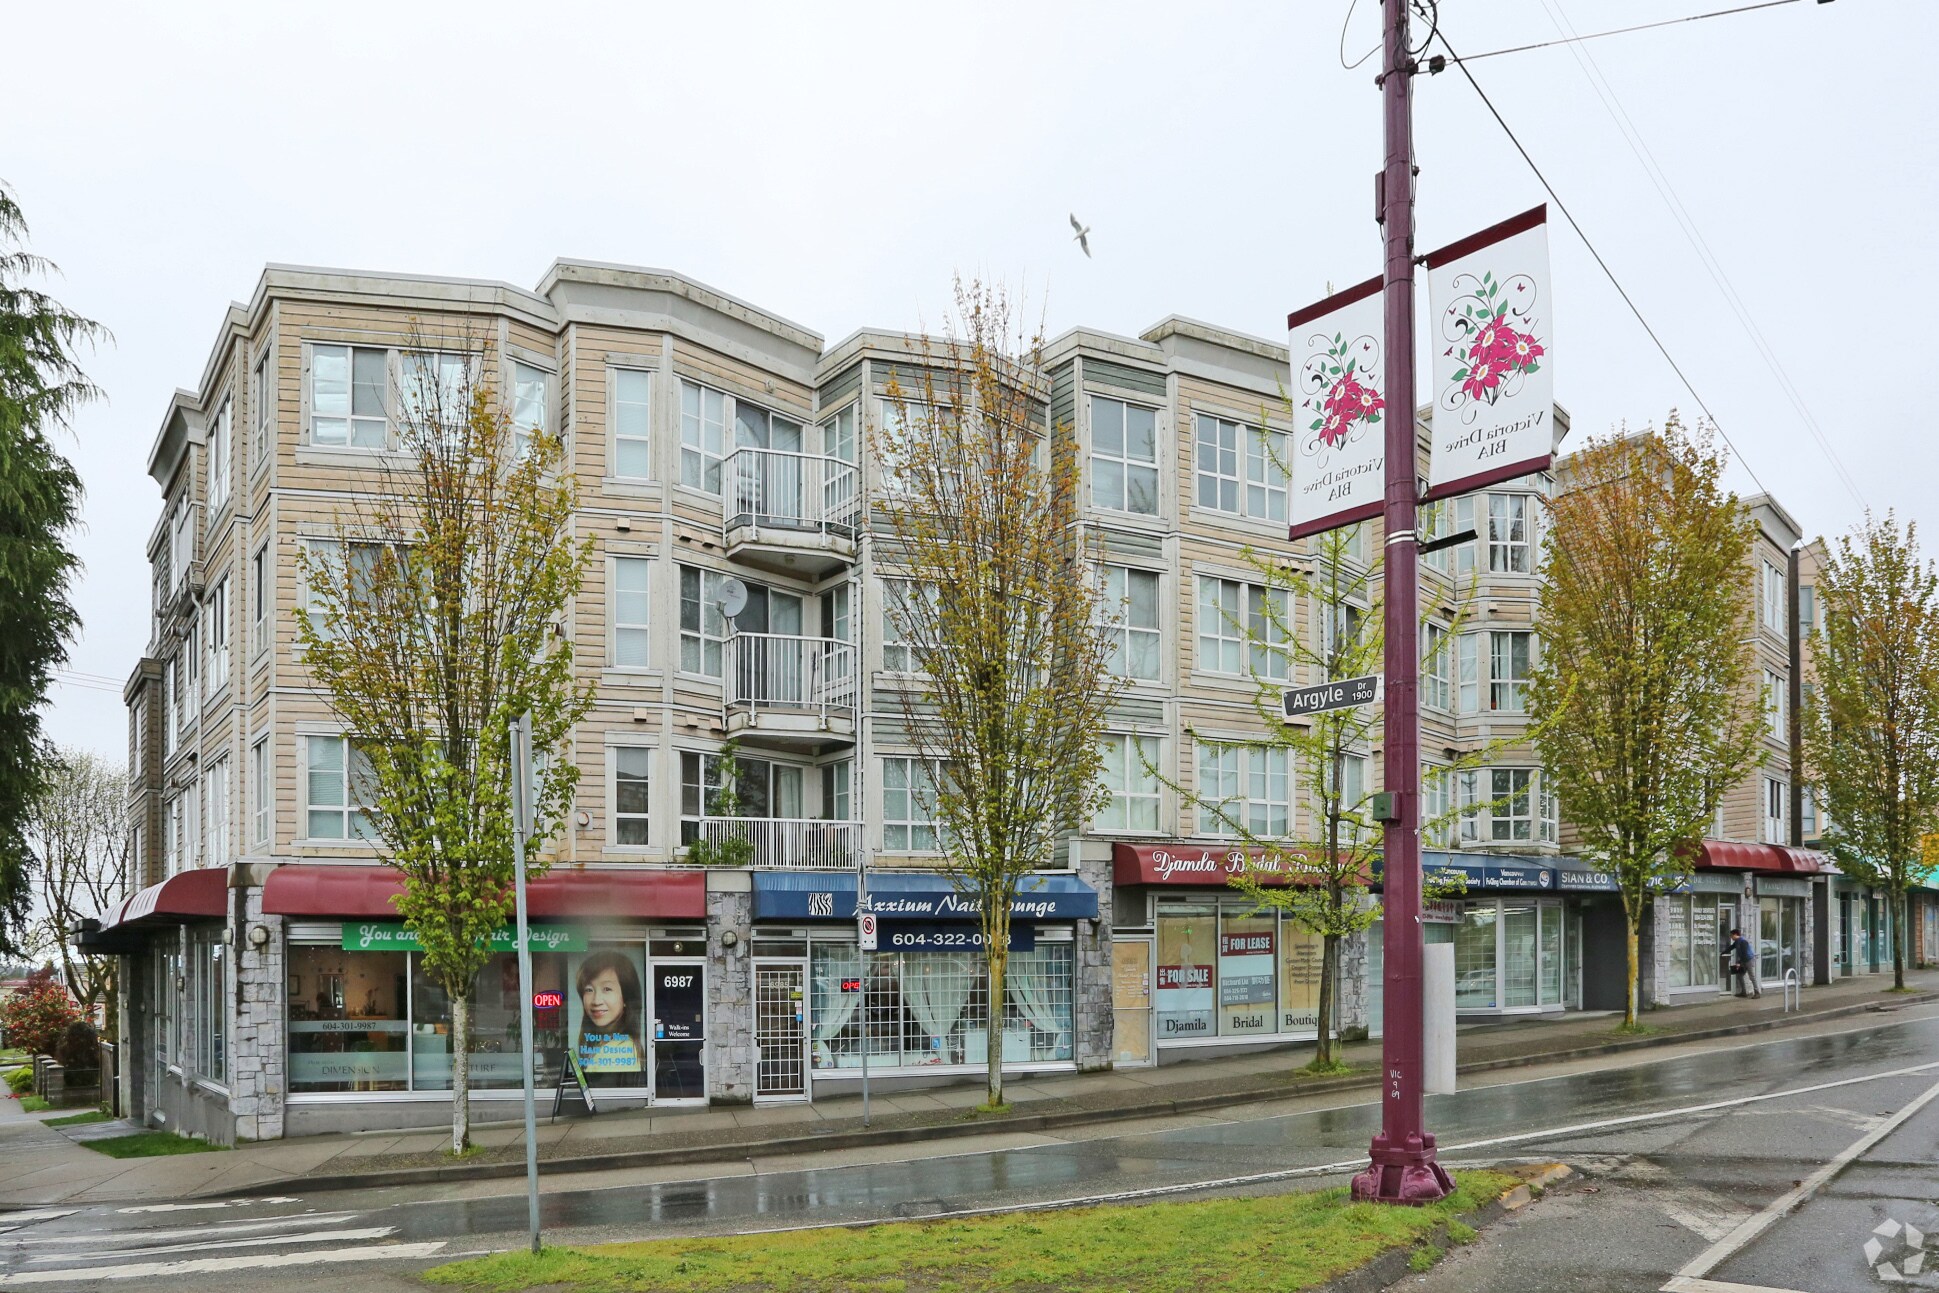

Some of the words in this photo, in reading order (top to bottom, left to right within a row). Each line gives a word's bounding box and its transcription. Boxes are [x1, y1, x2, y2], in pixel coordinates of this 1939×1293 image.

[1293, 687, 1344, 710] Argyle
[1357, 682, 1367, 690] Dr
[1352, 689, 1373, 701] 1900
[1153, 850, 1218, 880] Djamila
[1561, 871, 1586, 883] SIAN
[1586, 873, 1593, 884] &
[1594, 872, 1610, 884] CO.
[852, 893, 932, 916] Axxium
[989, 896, 1056, 918] ounge
[359, 924, 392, 947] You
[892, 933, 1012, 946] 604-322-008
[1230, 938, 1246, 951] FOR
[1247, 936, 1270, 950] LEASE
[663, 975, 694, 988] 6987
[1167, 969, 1186, 983] FOR
[1187, 968, 1209, 983] SALE
[842, 981, 861, 990] OPE
[534, 994, 561, 1006] OPEN
[322, 1021, 377, 1031] 604-301-9987
[1166, 1018, 1207, 1034] Djamila
[1232, 1015, 1264, 1029] Bridal
[579, 1057, 637, 1066] 604-301-9987
[1390, 1069, 1403, 1079] VIC
[1392, 1080, 1398, 1089] 9
